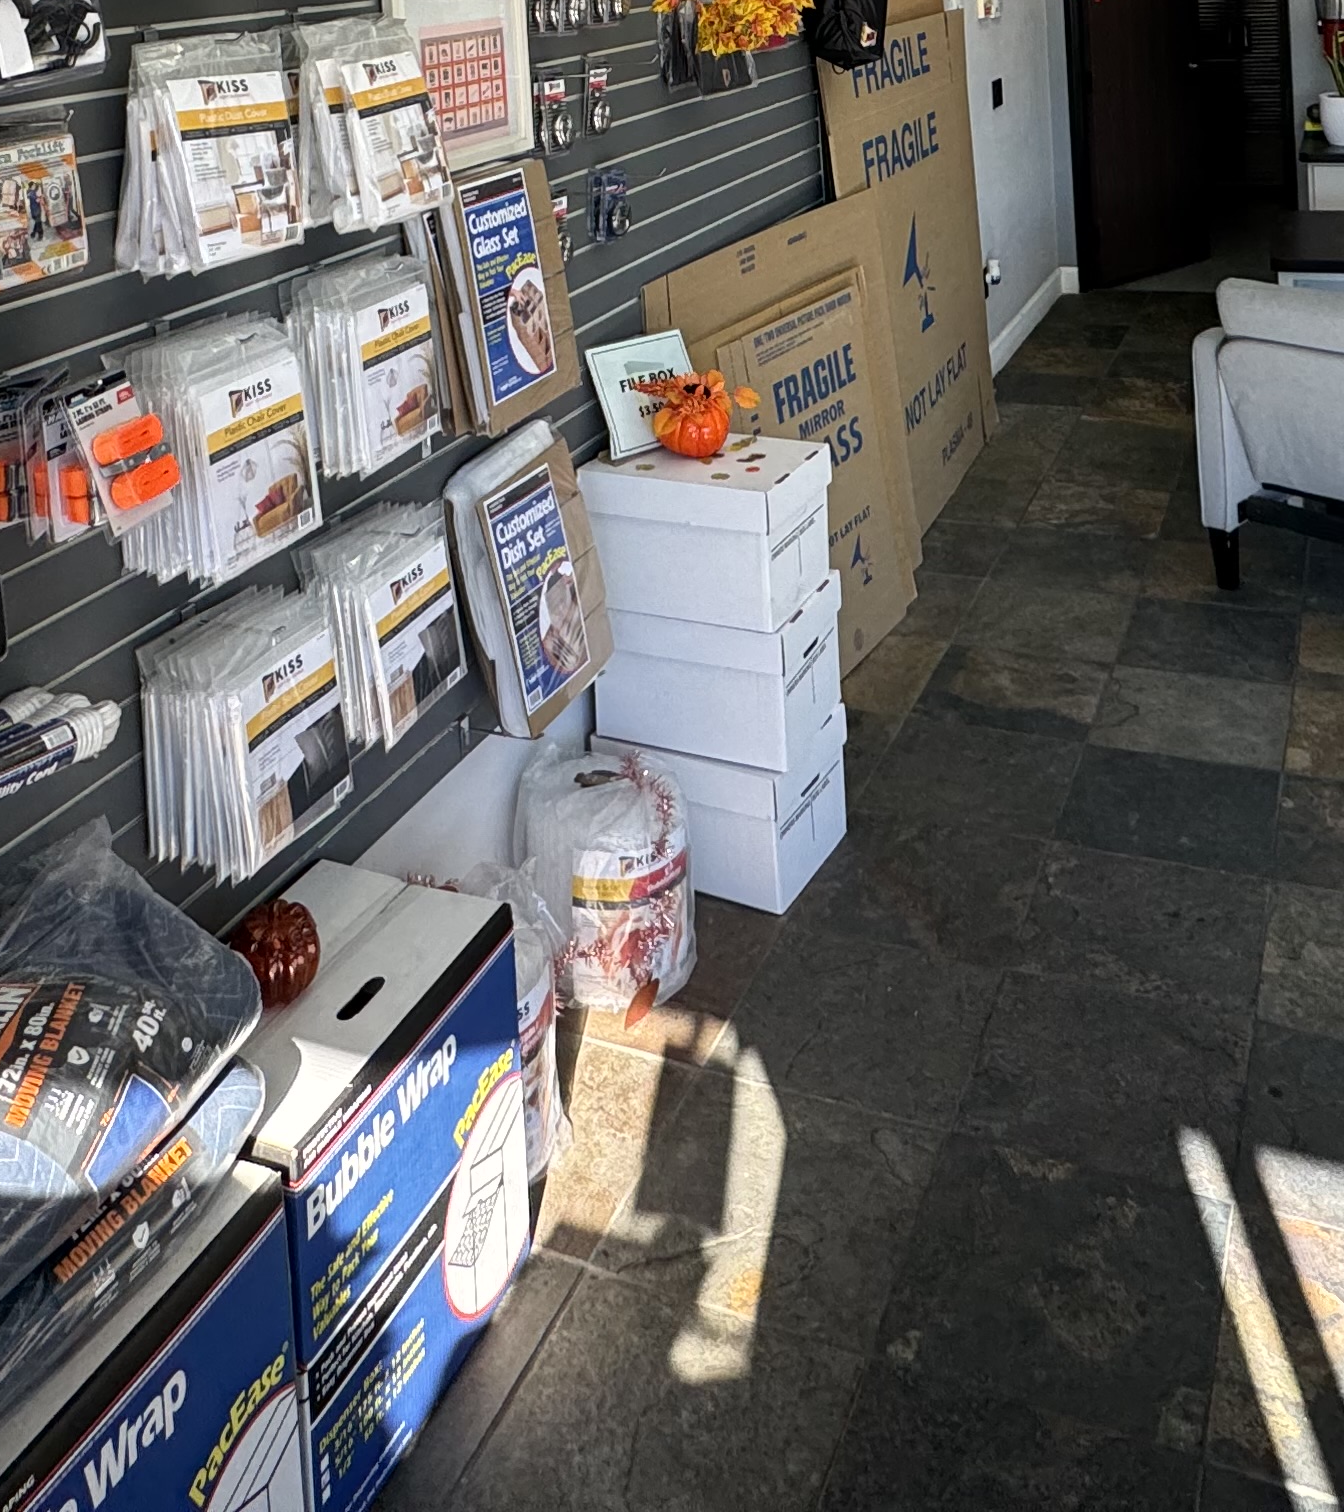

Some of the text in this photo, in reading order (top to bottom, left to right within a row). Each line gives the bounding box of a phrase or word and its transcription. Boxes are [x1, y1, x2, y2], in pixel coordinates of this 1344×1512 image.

[376, 60, 396, 74] KISS
[852, 32, 930, 98] FRAGILE
[216, 79, 249, 94] KISS
[862, 111, 939, 188] FRAGILE
[468, 197, 528, 235] Customized
[473, 226, 519, 259] Glass Set
[505, 251, 537, 280] PacEase
[389, 300, 409, 319] KISS
[243, 378, 272, 402] KISS
[772, 343, 856, 424] FRAGILE
[905, 342, 967, 436] NOT LAY FLAT
[798, 400, 845, 439] MIRROR
[824, 416, 863, 469] ASS
[496, 490, 555, 544] Customized
[840, 520, 855, 541] LAY
[855, 505, 871, 529] FLAT
[501, 525, 546, 569] Dish Set
[536, 545, 566, 582] PacEase
[401, 563, 424, 588] KISS
[275, 654, 303, 683] KISS
[26, 762, 58, 786] Cord
[23, 1001, 56, 1037] 80in.
[131, 1013, 161, 1054] 40
[4, 1053, 54, 1130] MOVING
[40, 982, 86, 1052] BLANKET
[453, 1045, 515, 1149] PacEase
[307, 1110, 395, 1241] Bubble
[397, 1034, 457, 1126] Wrap
[53, 1210, 125, 1283] MOVING
[120, 1136, 193, 1215] BLANKET
[83, 1369, 187, 1509] Wrap
[189, 1353, 287, 1508] PacEase
